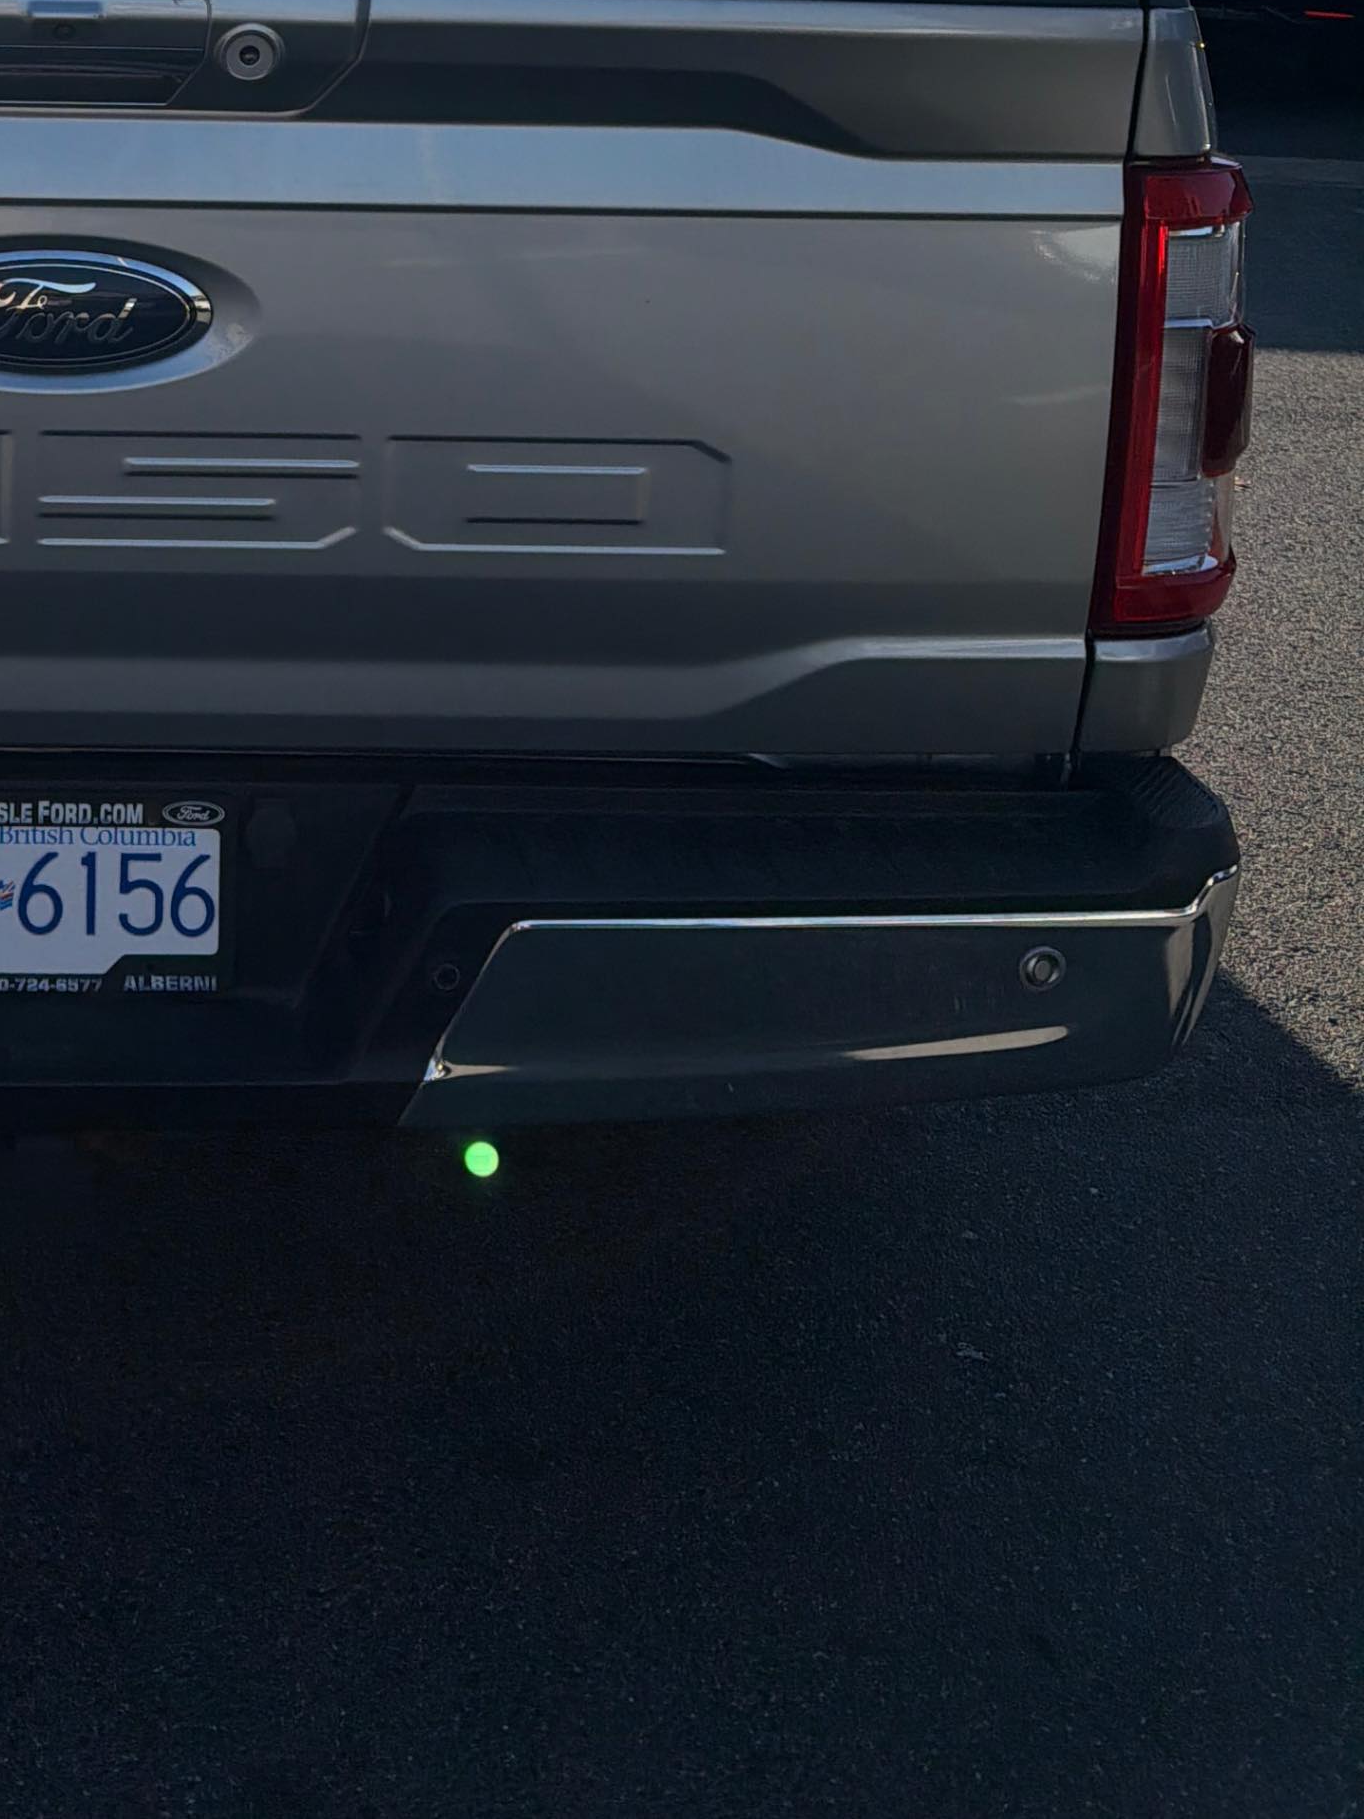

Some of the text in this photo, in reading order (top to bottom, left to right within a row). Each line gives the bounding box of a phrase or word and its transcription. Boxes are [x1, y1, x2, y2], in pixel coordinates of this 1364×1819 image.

[176, 806, 210, 822] Ford
[80, 828, 197, 848] Columbia
[17, 851, 216, 938] 6156
[123, 976, 218, 992] ALBERNI
